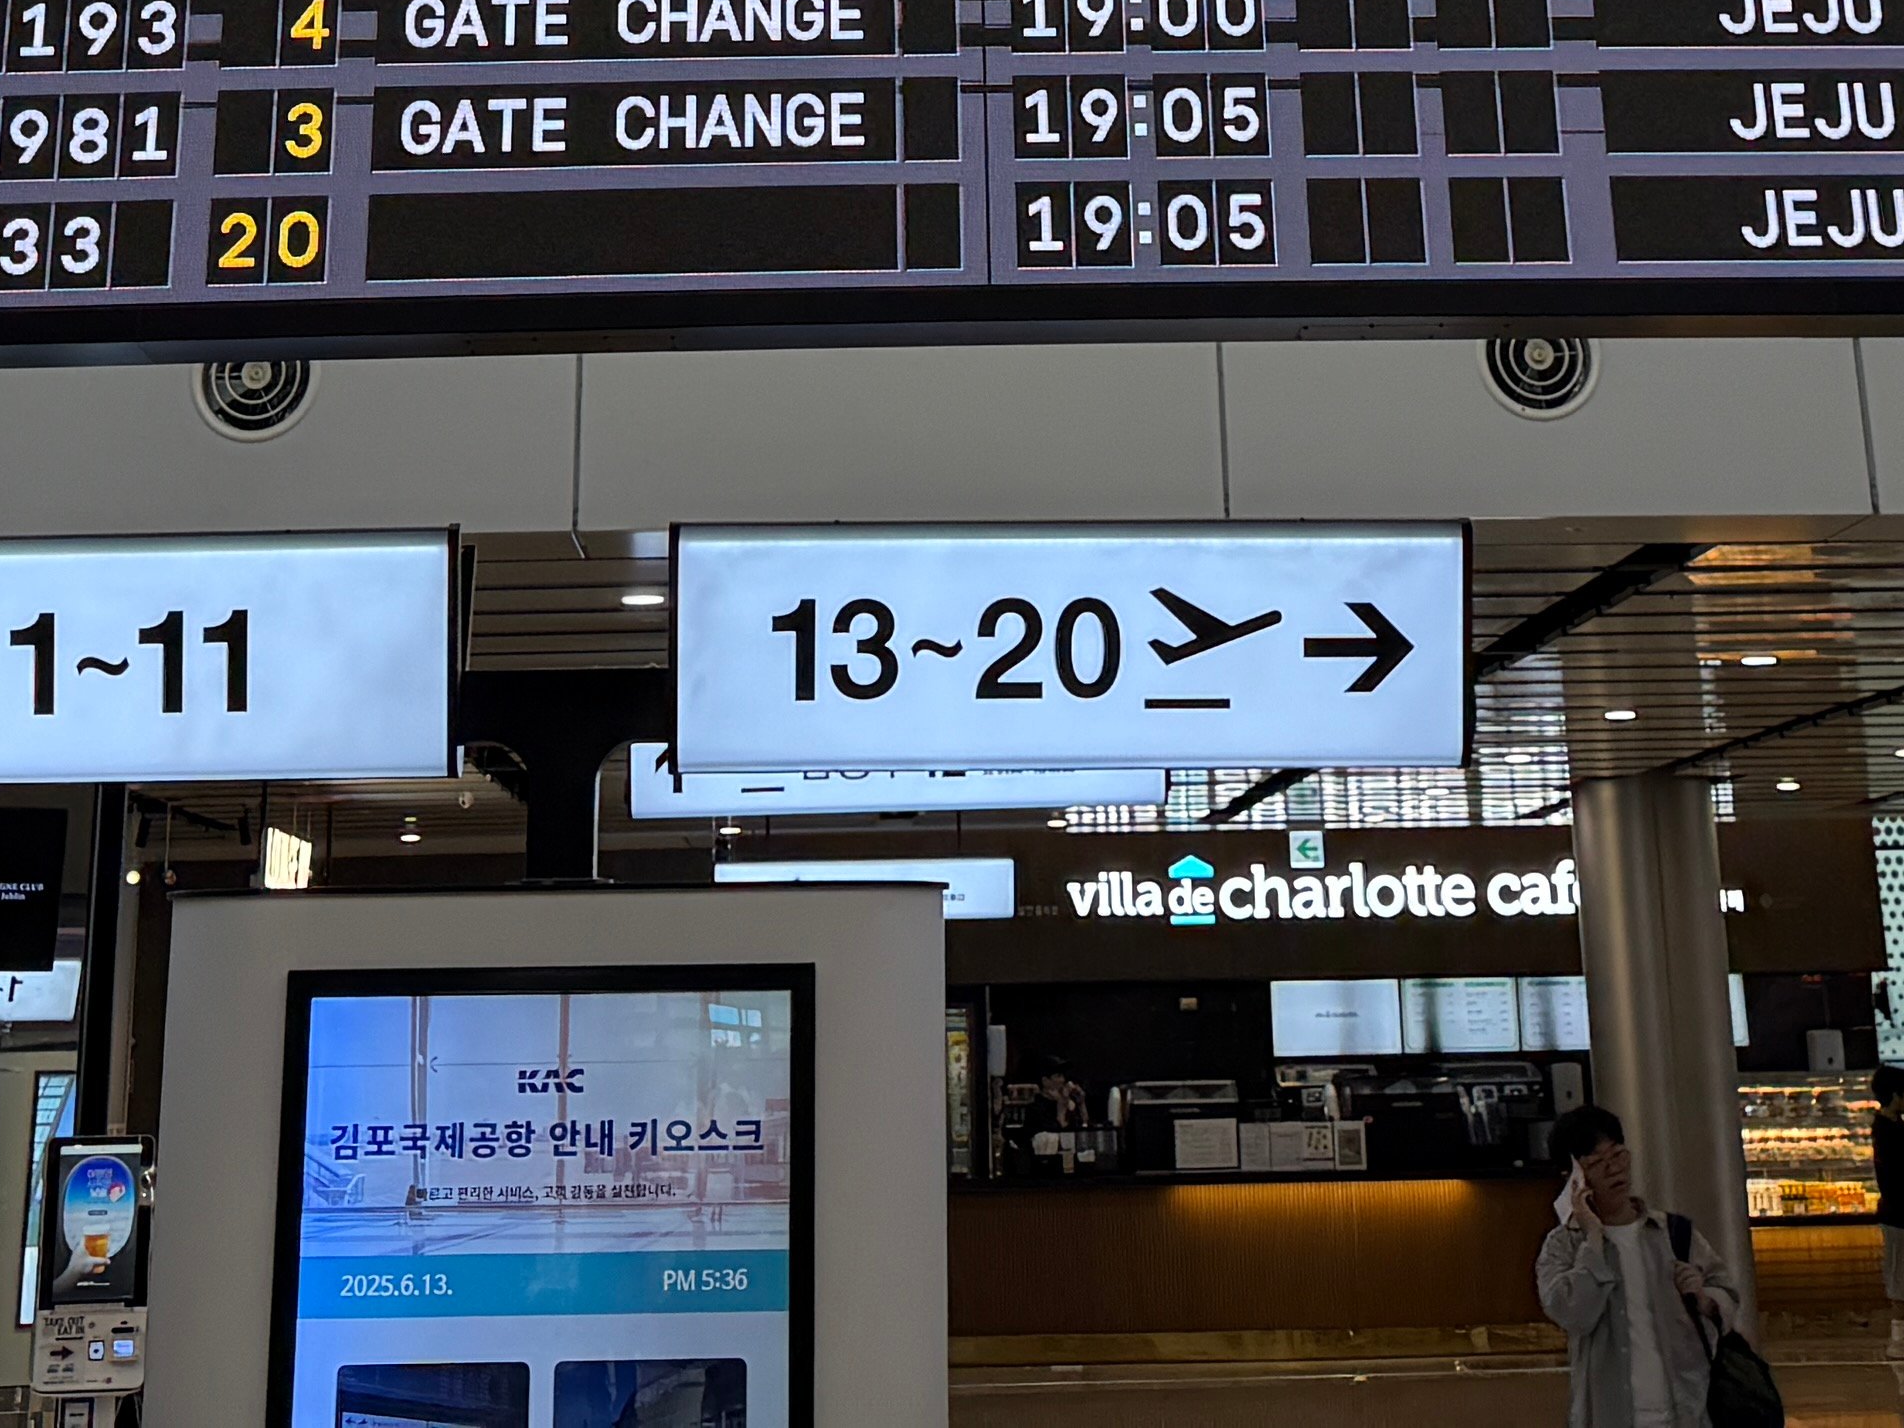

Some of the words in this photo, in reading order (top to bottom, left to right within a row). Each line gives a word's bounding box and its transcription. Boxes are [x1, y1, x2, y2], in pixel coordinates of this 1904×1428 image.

[1025, 86, 1259, 143] 19:05
[1729, 82, 1895, 140] JEJU
[218, 211, 319, 268] 20
[1028, 193, 1265, 252] 19:05
[8, 609, 249, 715] 1~11
[771, 598, 1121, 703] 13~20
[1067, 871, 1164, 917] villa
[1168, 876, 1215, 917] de
[1218, 862, 1478, 921] charlotte
[1486, 859, 1580, 917] caf
[330, 1119, 536, 1162] 김포국제공항
[549, 1118, 615, 1159] 안내
[628, 1116, 764, 1155] 키오스크
[340, 1273, 454, 1299] 2025.6.13.
[663, 1269, 697, 1292] PM
[701, 1267, 748, 1292] 5:36
